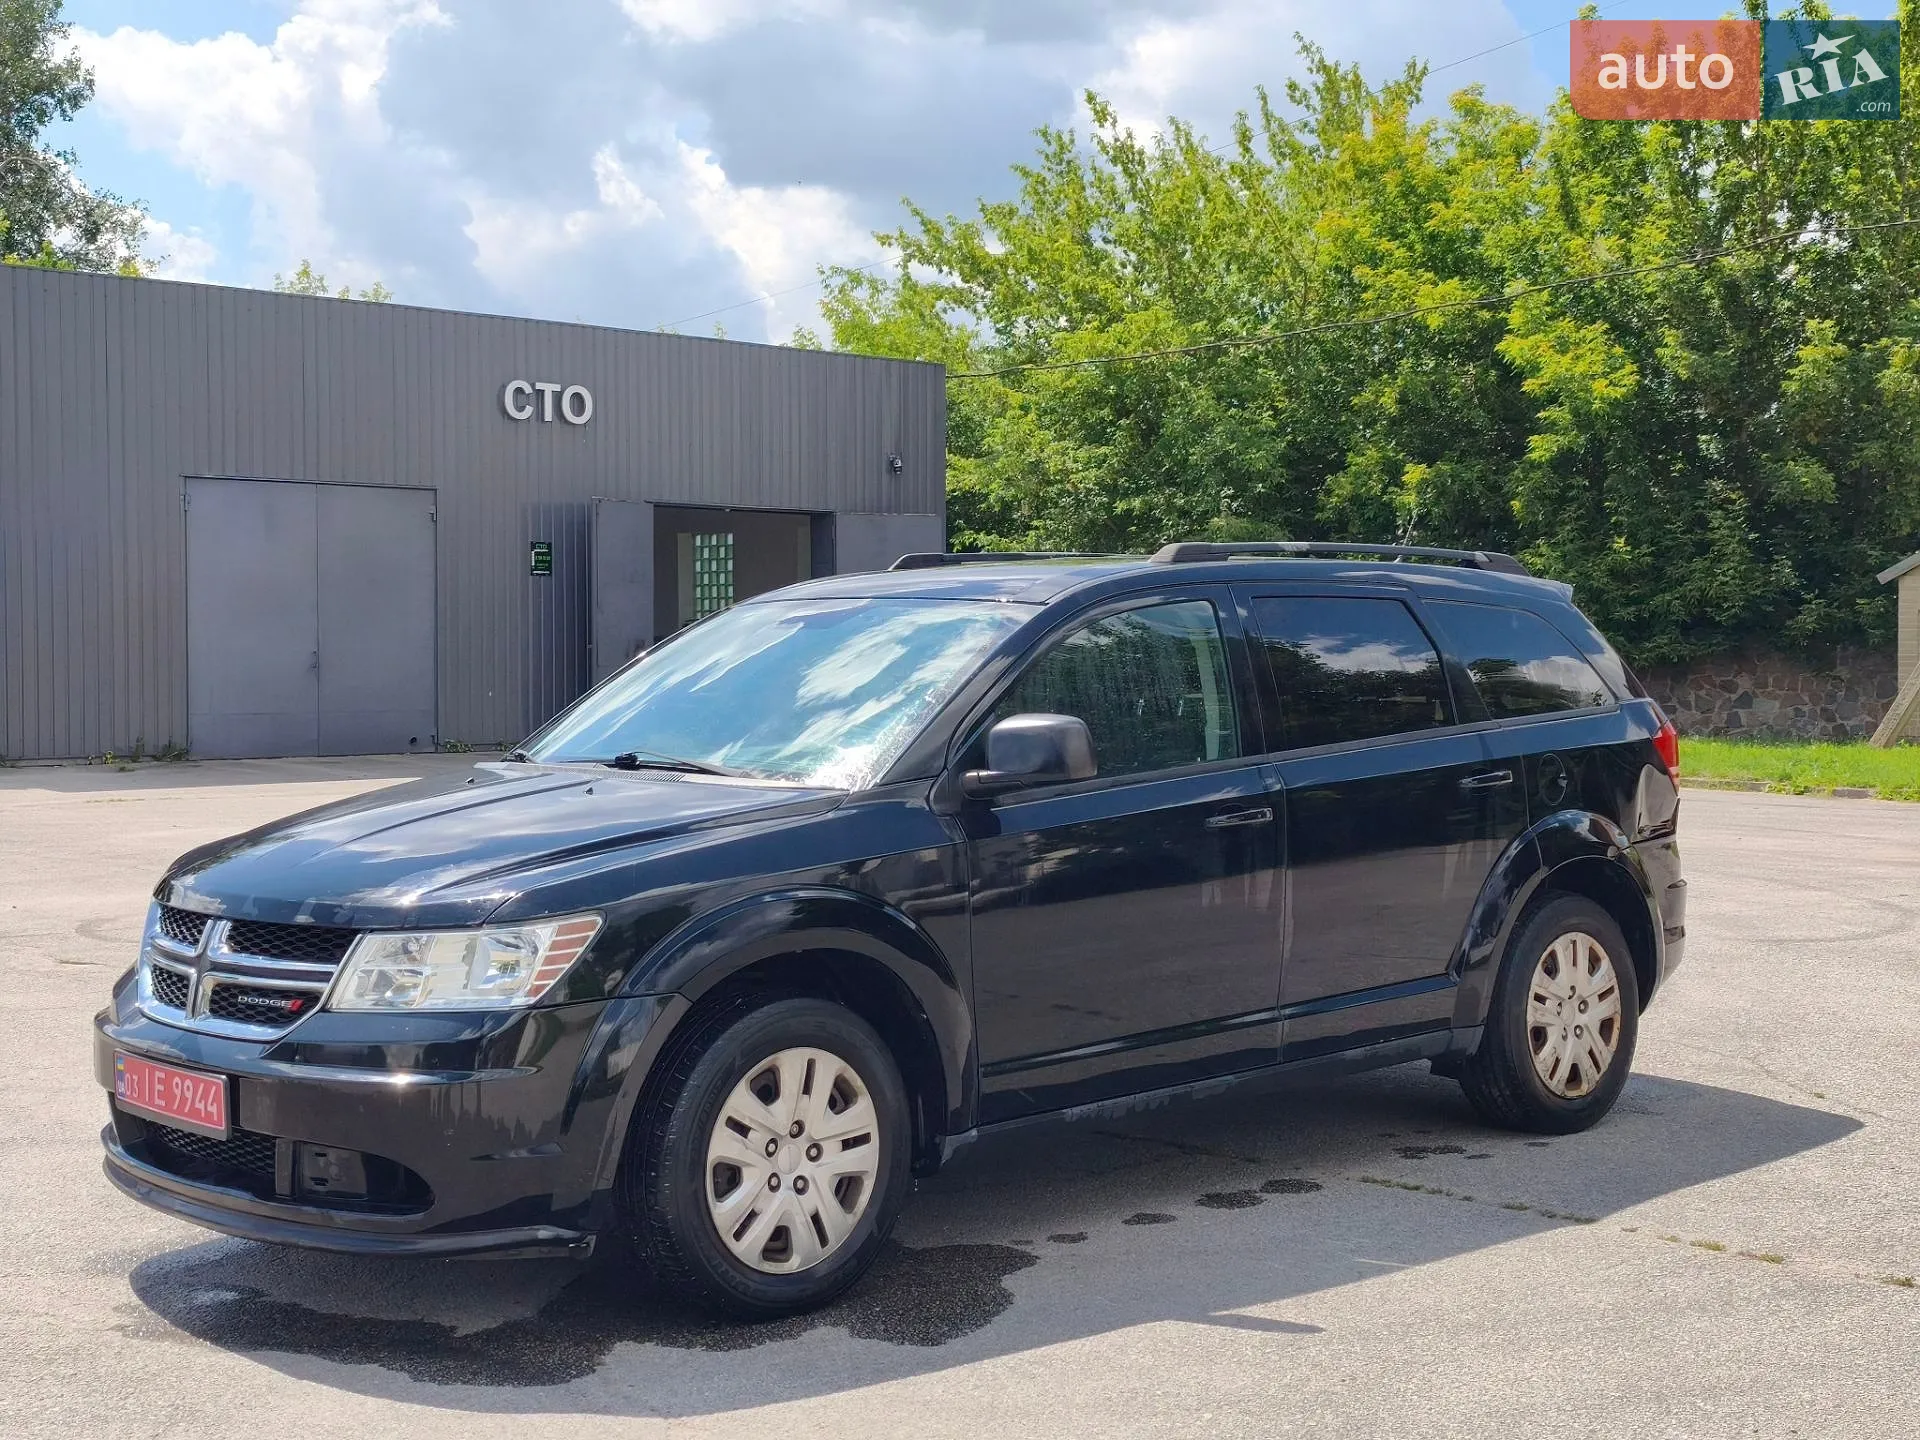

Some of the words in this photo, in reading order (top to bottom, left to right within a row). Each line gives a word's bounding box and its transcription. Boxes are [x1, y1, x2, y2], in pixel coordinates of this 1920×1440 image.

[504, 380, 593, 425] СТО
[238, 996, 292, 1008] DODGE
[124, 1073, 139, 1098] 03
[172, 1076, 218, 1121] 9944
